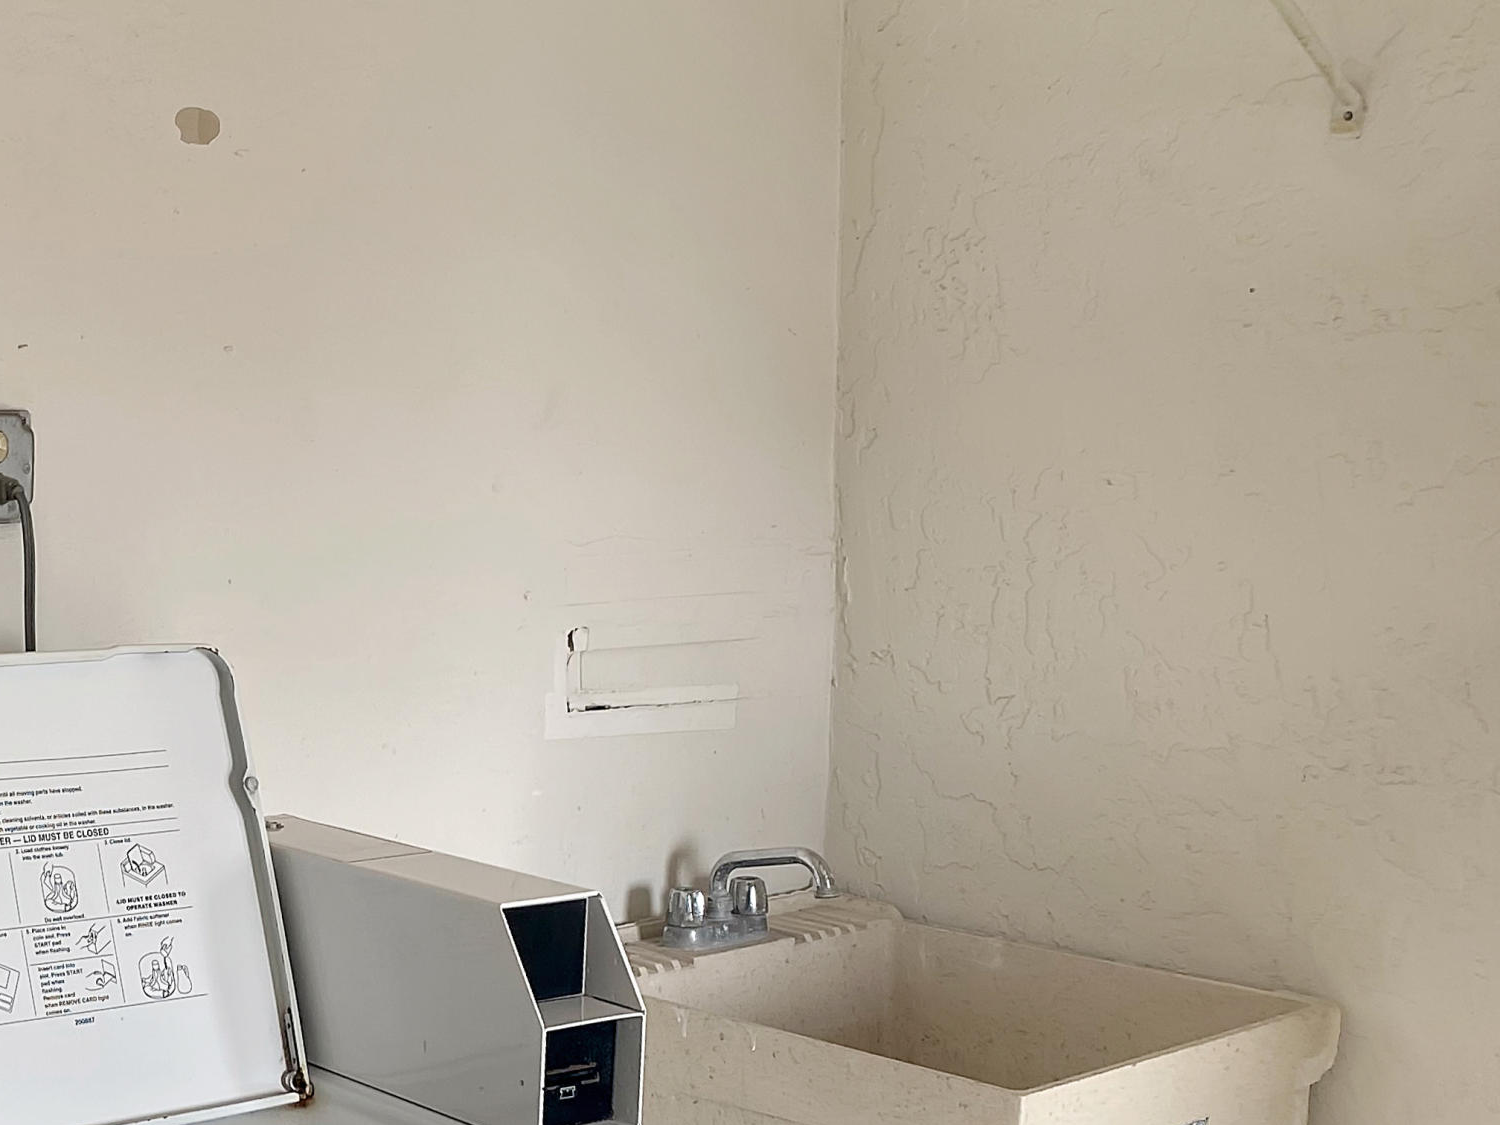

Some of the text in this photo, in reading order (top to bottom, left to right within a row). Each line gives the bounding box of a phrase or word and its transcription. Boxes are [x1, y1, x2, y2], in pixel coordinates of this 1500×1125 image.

[22, 834, 37, 844] LID
[38, 832, 61, 842] MUST
[63, 831, 74, 840] BE
[76, 827, 109, 838] CLOSED
